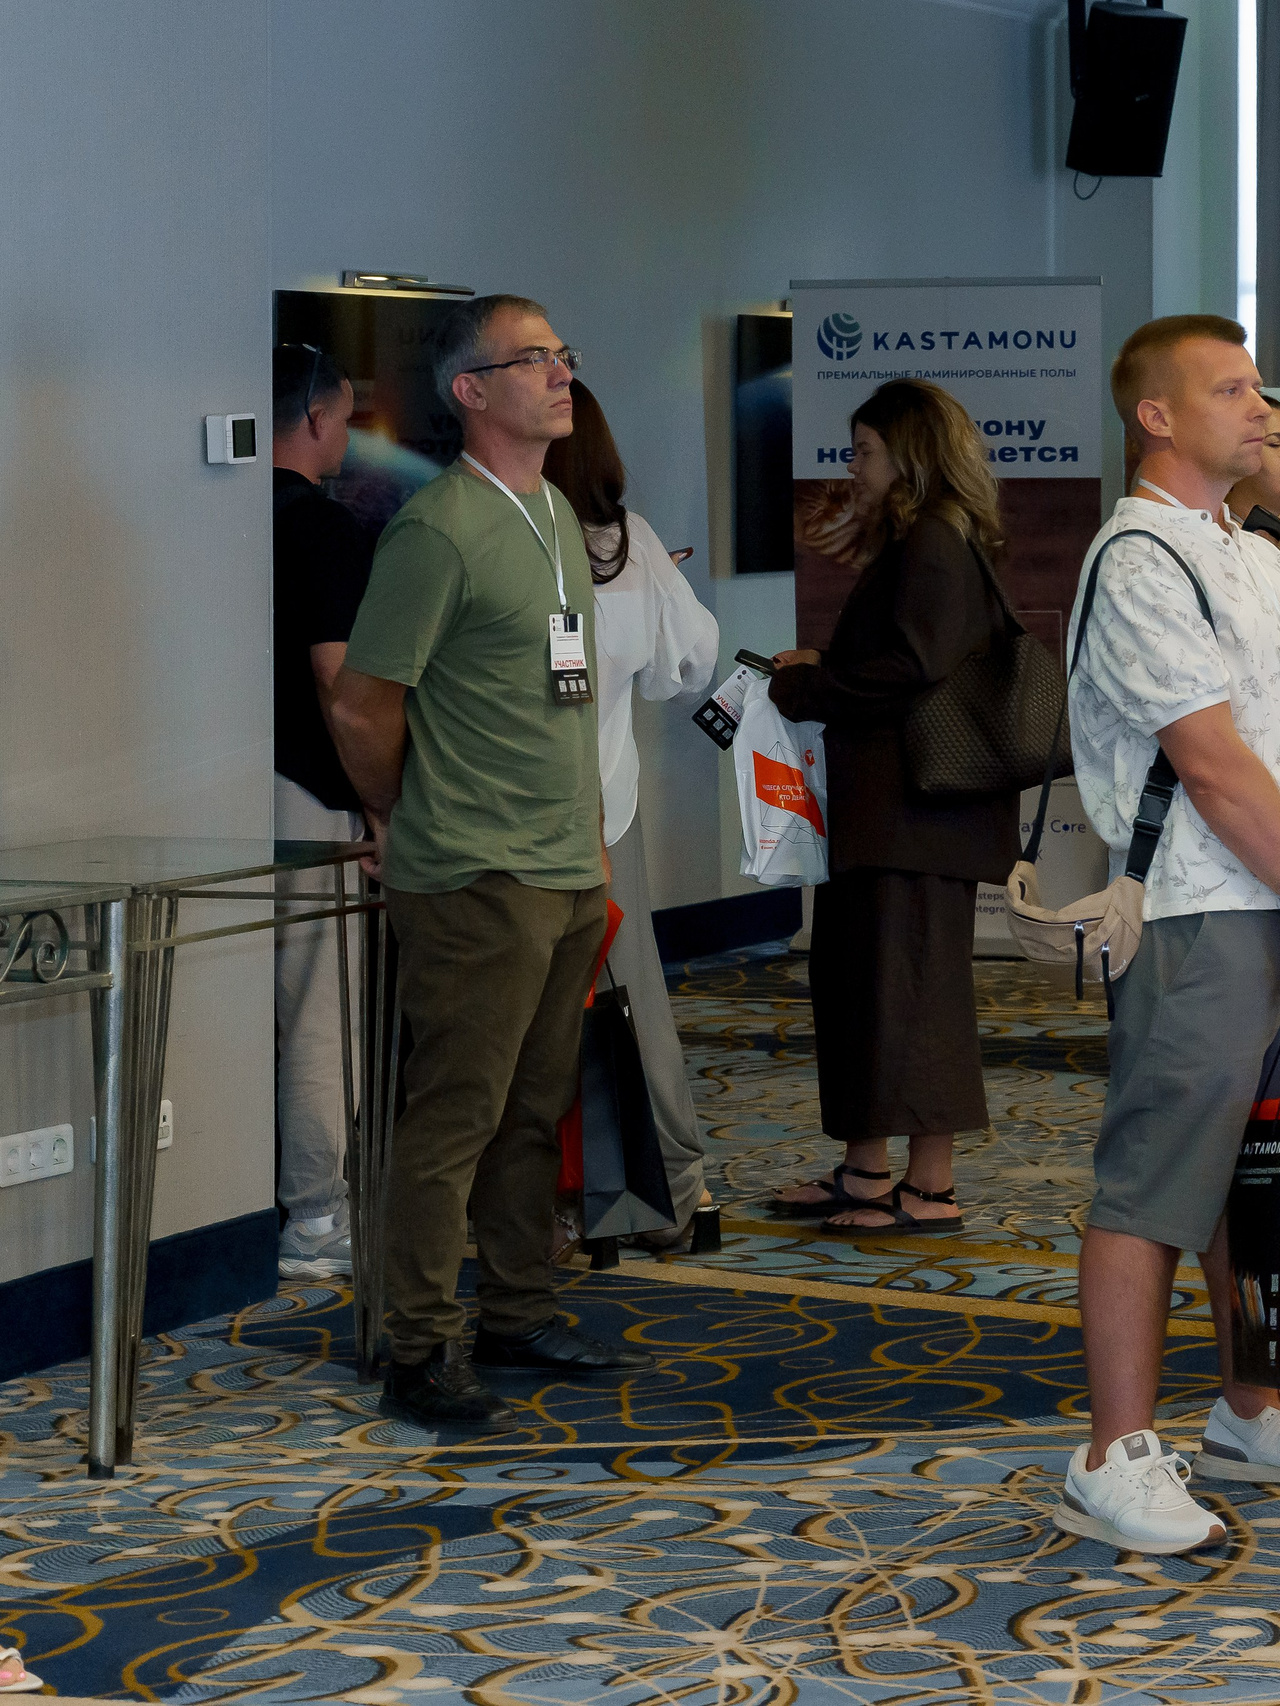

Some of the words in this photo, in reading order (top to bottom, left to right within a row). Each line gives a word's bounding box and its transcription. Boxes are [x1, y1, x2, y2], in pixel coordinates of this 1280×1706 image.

[872, 330, 1077, 351] KASTAMONU
[817, 370, 911, 380] ПРЕМИАЛЬНЫЕ
[915, 369, 1037, 379] ЛАМИНИРОВАННЫЕ
[1040, 368, 1077, 378] ПОЛЫ
[975, 420, 1046, 440] ону
[817, 448, 855, 463] не
[554, 659, 585, 668] УЧАСТНИК
[978, 892, 1004, 901] steps
